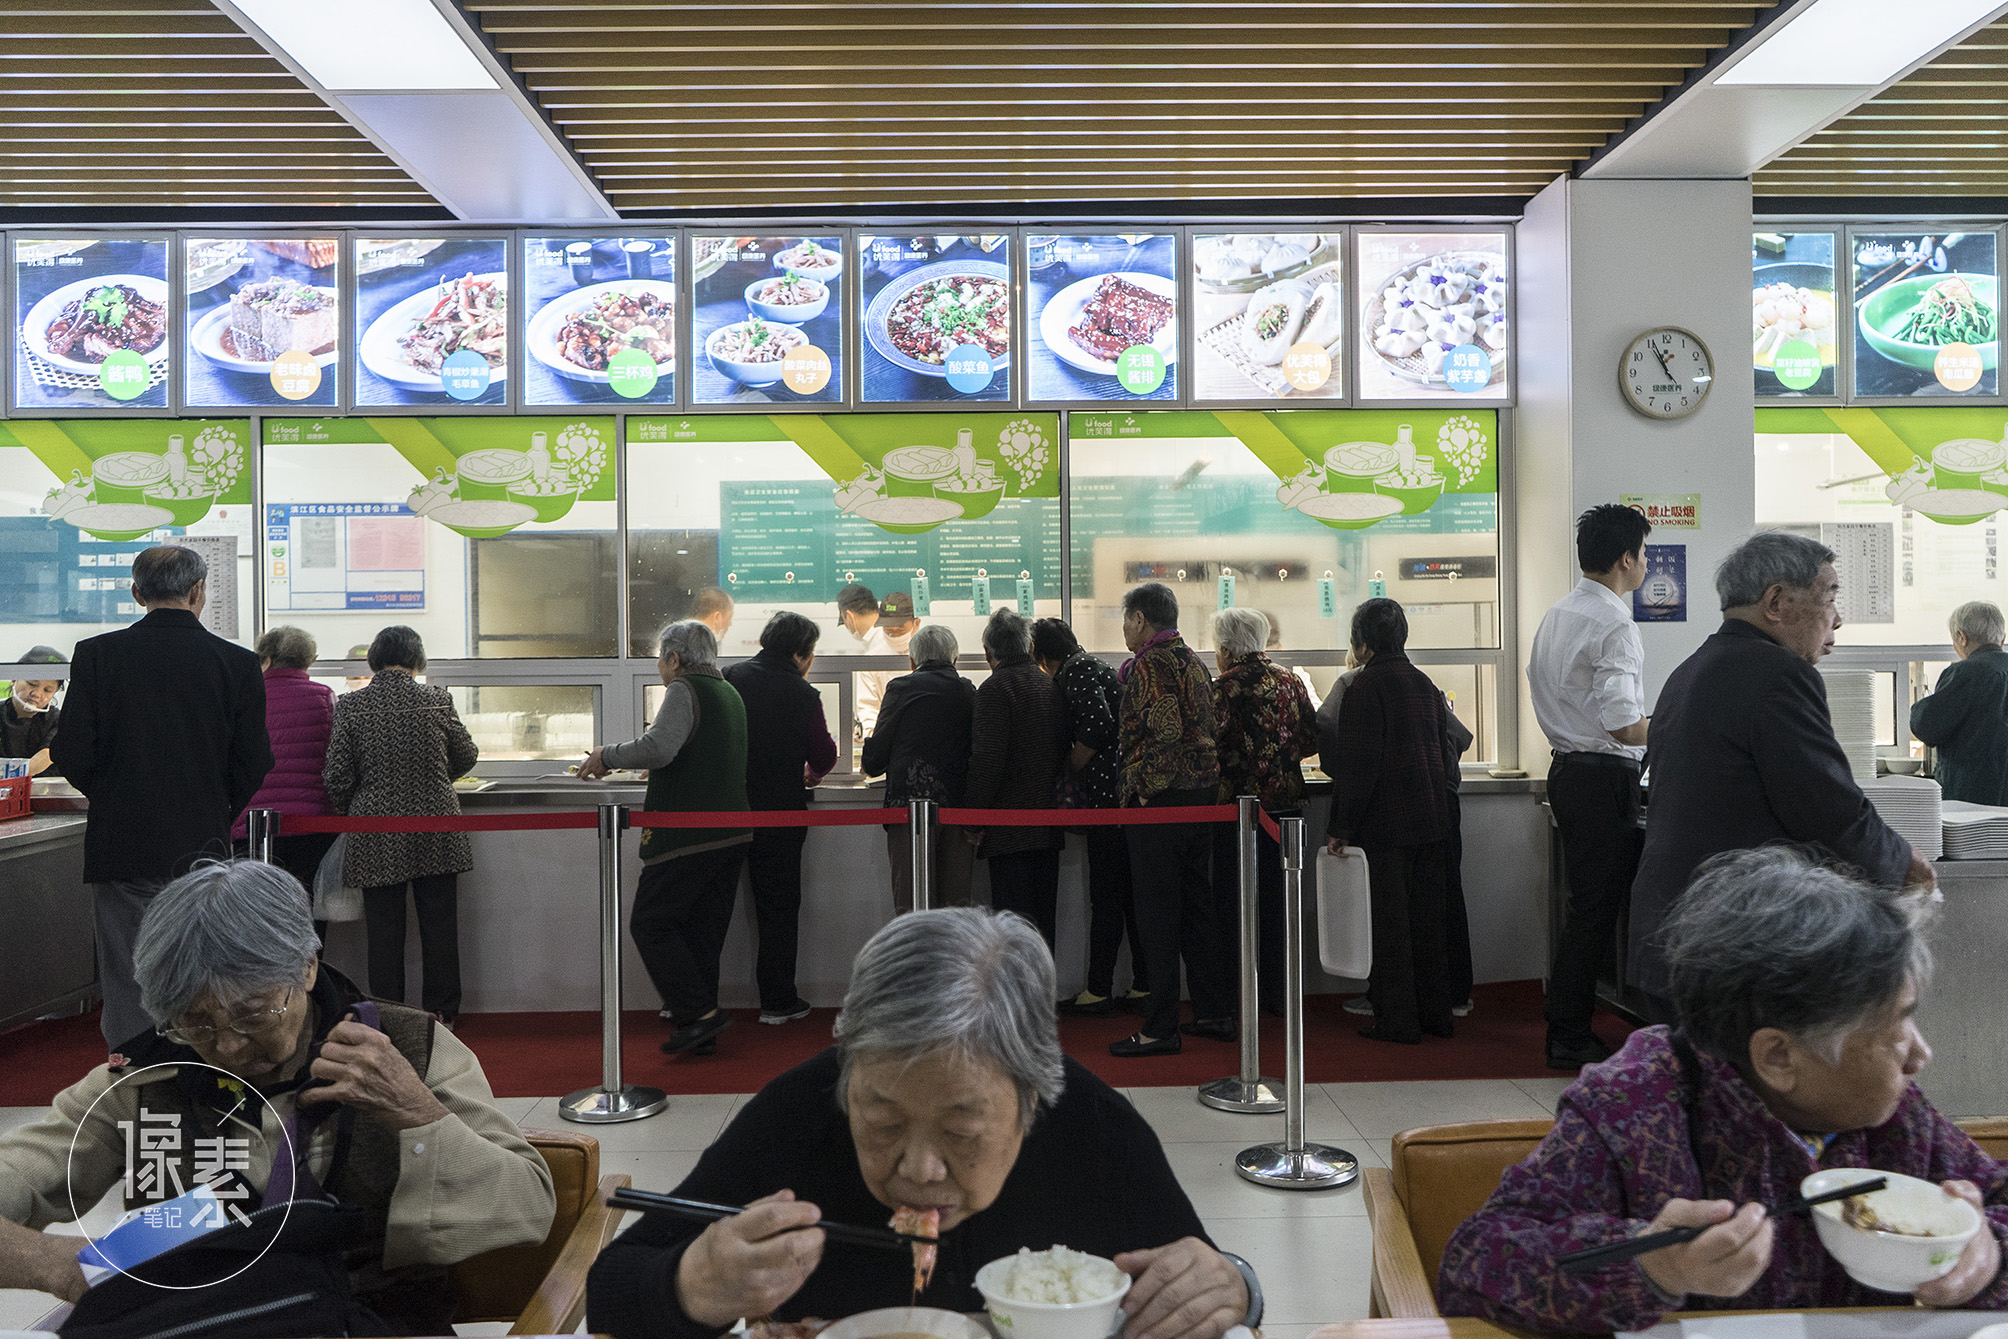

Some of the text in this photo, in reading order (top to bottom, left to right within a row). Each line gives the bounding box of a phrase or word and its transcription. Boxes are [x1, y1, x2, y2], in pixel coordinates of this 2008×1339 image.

[1662, 334, 1672, 344] 12
[1682, 339, 1685, 348] 1
[1127, 354, 1155, 368] 无锡
[1453, 353, 1481, 367] 奶香
[1634, 352, 1643, 362] 10
[1692, 351, 1700, 361] 2
[611, 365, 654, 379] 三杯鸡
[948, 360, 990, 375] 酸菜鱼
[107, 365, 143, 383] 酱鸭
[1127, 370, 1155, 384] 酱排
[1293, 370, 1321, 384] 大包
[1629, 368, 1637, 378] 9
[795, 373, 818, 384] 丸子
[281, 379, 310, 393] 豆腐
[1635, 385, 1643, 395] 8
[1692, 386, 1699, 395] 4
[1648, 396, 1655, 406] 7
[1680, 397, 1688, 407] 5
[1664, 402, 1671, 412] 6
[290, 504, 400, 514] 滨江区食品安全监督公示牌
[1647, 505, 1695, 518] 禁止吸烟
[273, 561, 286, 577] B
